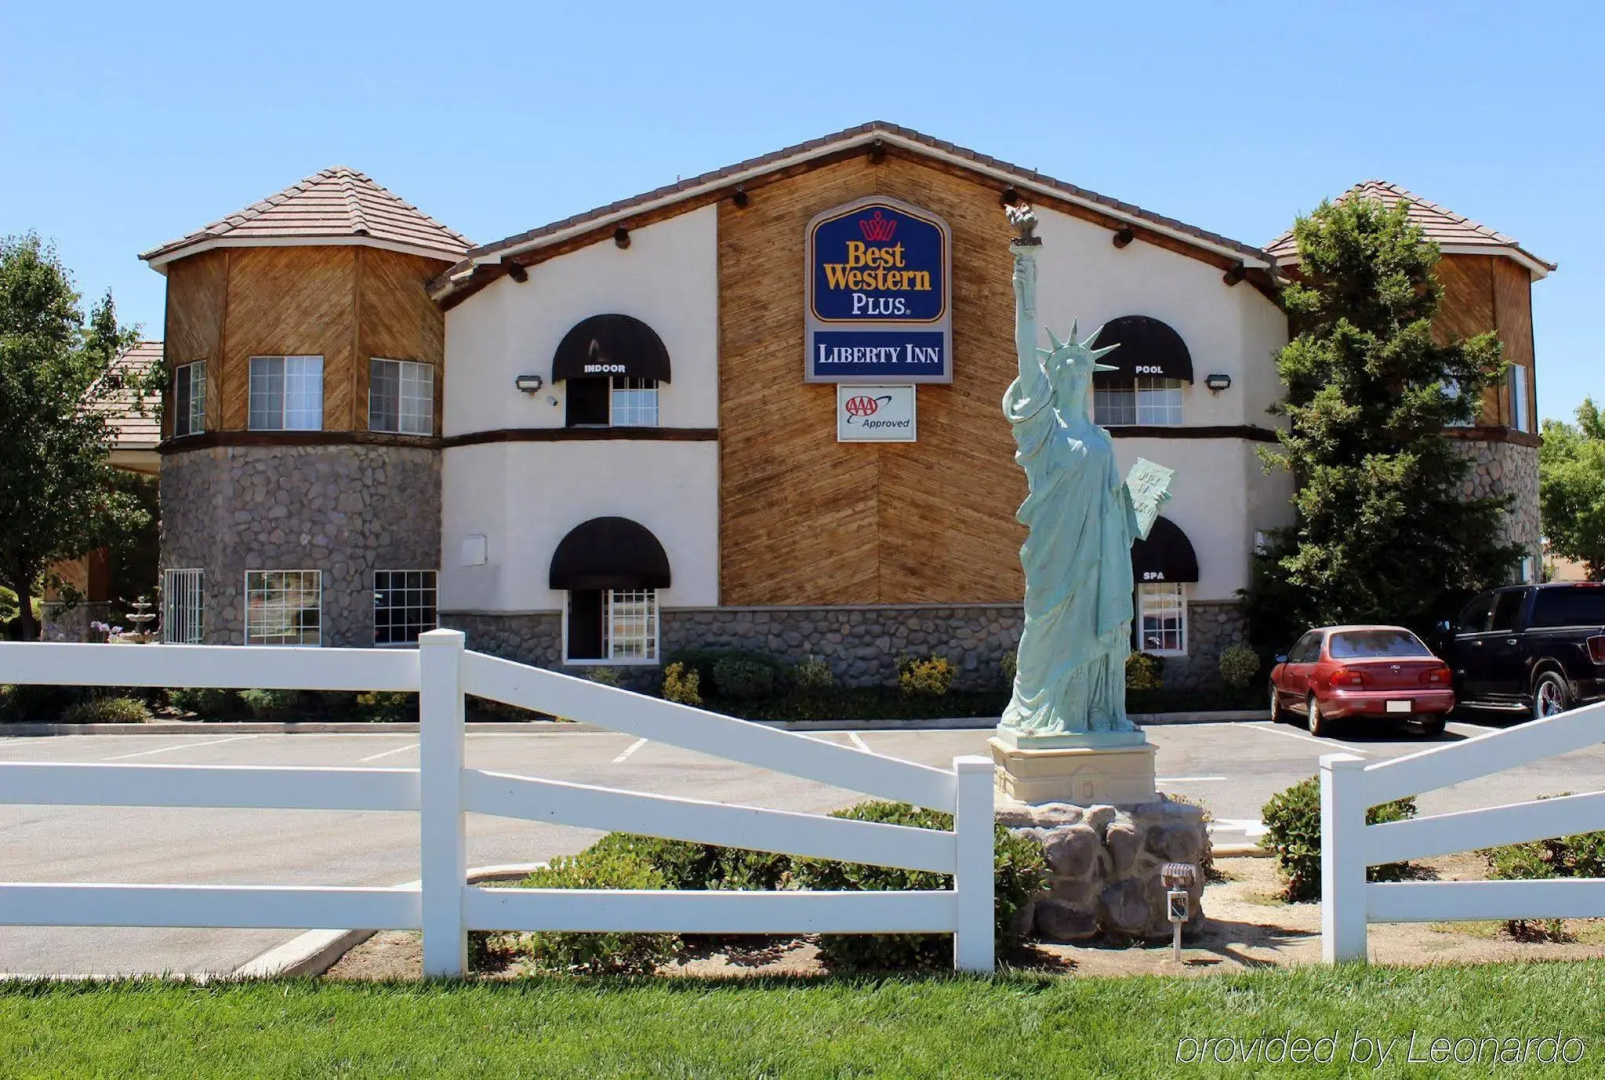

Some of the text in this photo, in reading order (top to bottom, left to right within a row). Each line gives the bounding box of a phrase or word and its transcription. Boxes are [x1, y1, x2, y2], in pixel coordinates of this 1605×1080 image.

[846, 241, 905, 268] Best
[823, 263, 932, 291] Western
[818, 344, 939, 363] LIBERTY INN
[584, 364, 625, 373] INDOOR
[1135, 365, 1163, 374] POOL
[848, 396, 876, 416] AAA
[862, 419, 910, 429] Approved
[1143, 571, 1165, 580] SPA
